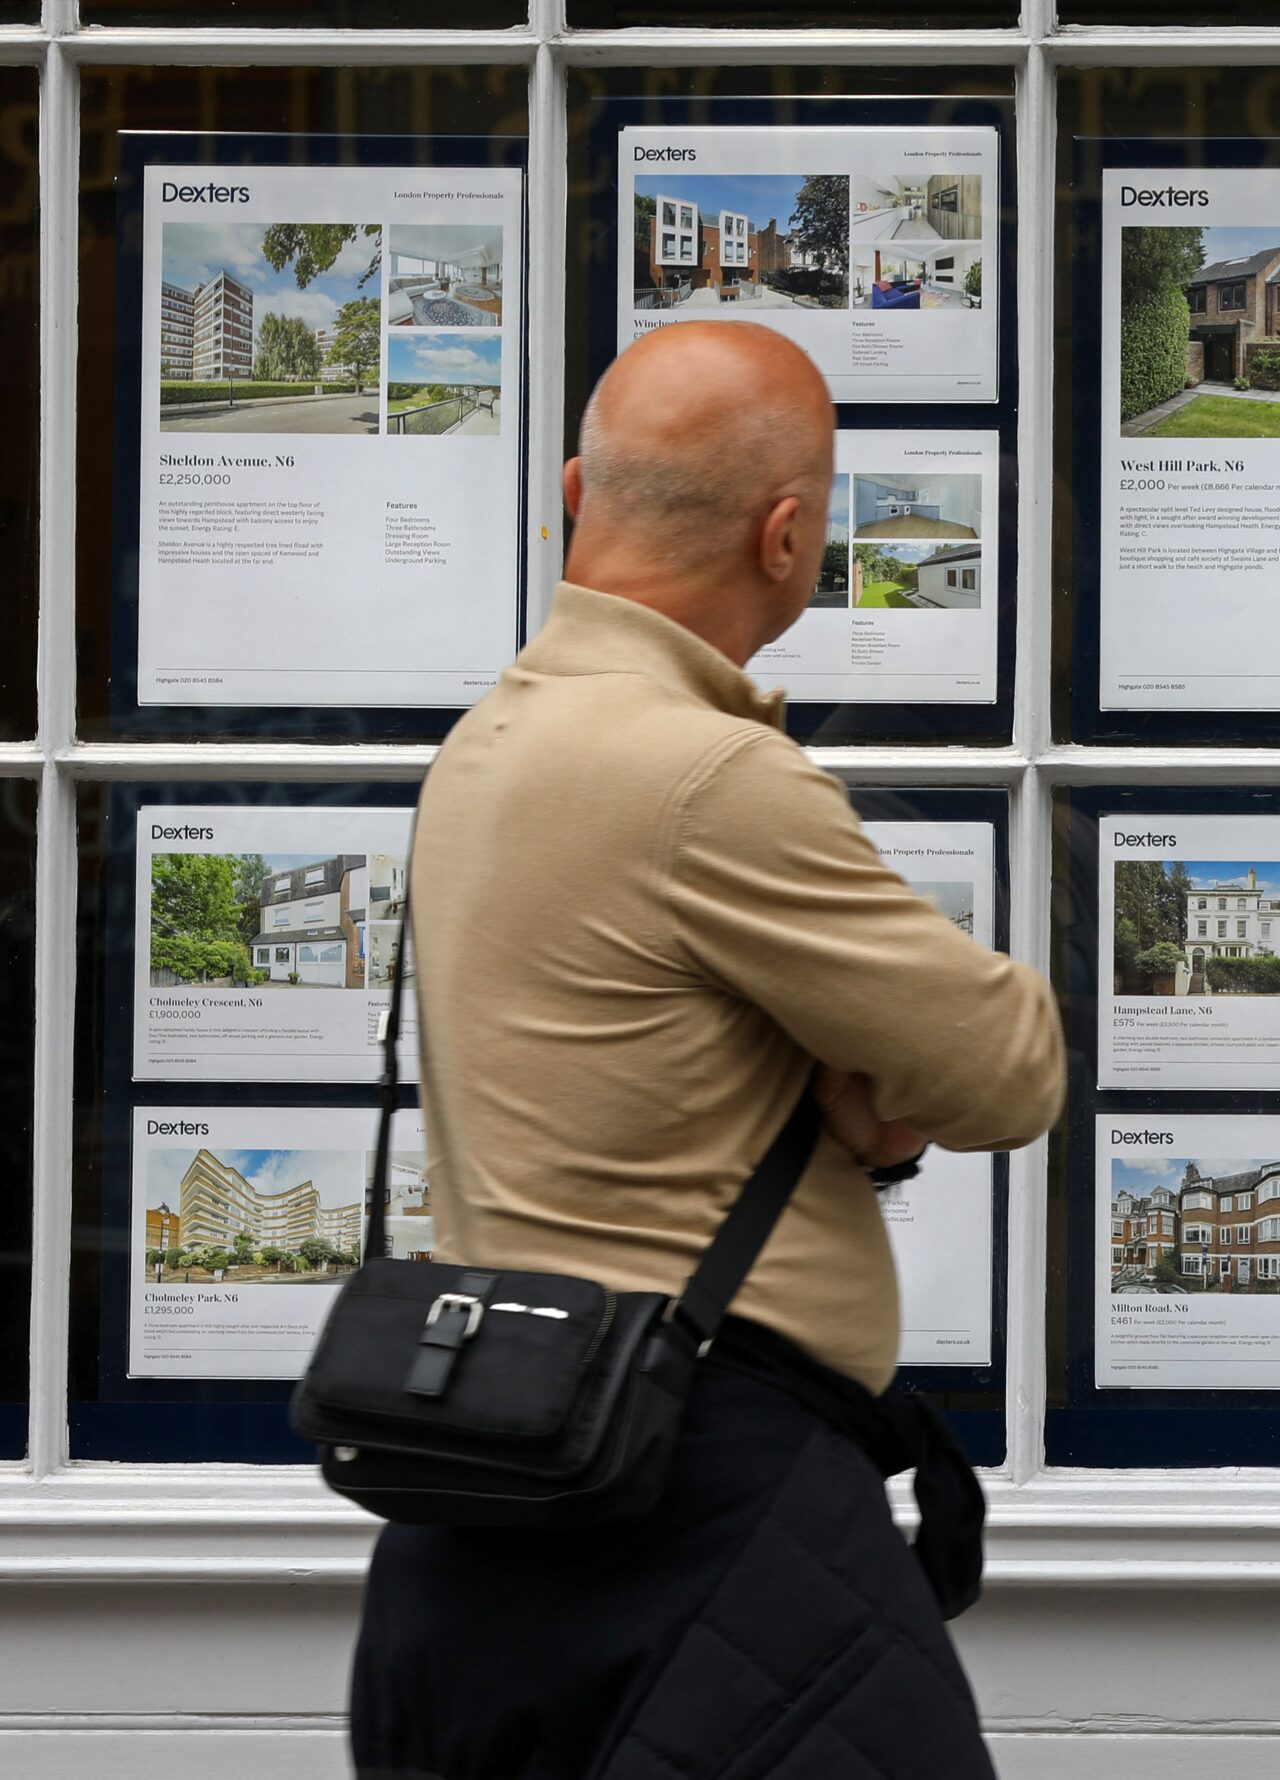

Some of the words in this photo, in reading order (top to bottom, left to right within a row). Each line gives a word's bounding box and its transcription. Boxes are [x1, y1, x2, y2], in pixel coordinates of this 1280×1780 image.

[634, 146, 696, 161] Dexters
[162, 182, 250, 203] Dexters
[423, 192, 454, 200] Property
[1121, 186, 1209, 207] Dexters
[160, 454, 214, 466] Sheldon
[218, 456, 272, 467] Avenue,
[275, 456, 294, 467] N6
[1120, 460, 1154, 472] West
[1159, 460, 1182, 472] Hill
[1187, 460, 1221, 472] Park,
[1225, 460, 1244, 472] N6
[159, 473, 231, 486] £2,250,000
[1120, 479, 1165, 491] £2,000
[386, 501, 418, 509] Features
[385, 532, 411, 541] Dressing
[385, 549, 421, 558] Outstanding
[424, 557, 447, 566] Parking
[152, 824, 214, 840] Dexters
[1114, 832, 1177, 847] Dexters
[893, 848, 925, 857] Property
[149, 998, 200, 1008] Cholmeley
[202, 998, 246, 1007] Crescent,
[248, 998, 263, 1007] N6
[149, 1010, 201, 1020] £1,900,000
[1114, 1006, 1168, 1016] Hampstead
[1170, 1006, 1196, 1015] Lane,
[1198, 1006, 1212, 1015] N6
[1113, 1018, 1135, 1027] £575
[147, 1120, 209, 1136] Dexters
[1111, 1129, 1174, 1145] Dexters
[144, 1293, 194, 1304] Cholmeley
[198, 1294, 222, 1303] Park,
[144, 1306, 194, 1316] £1,295,000
[1145, 1304, 1172, 1313] Road,
[1110, 1316, 1132, 1325] £461
